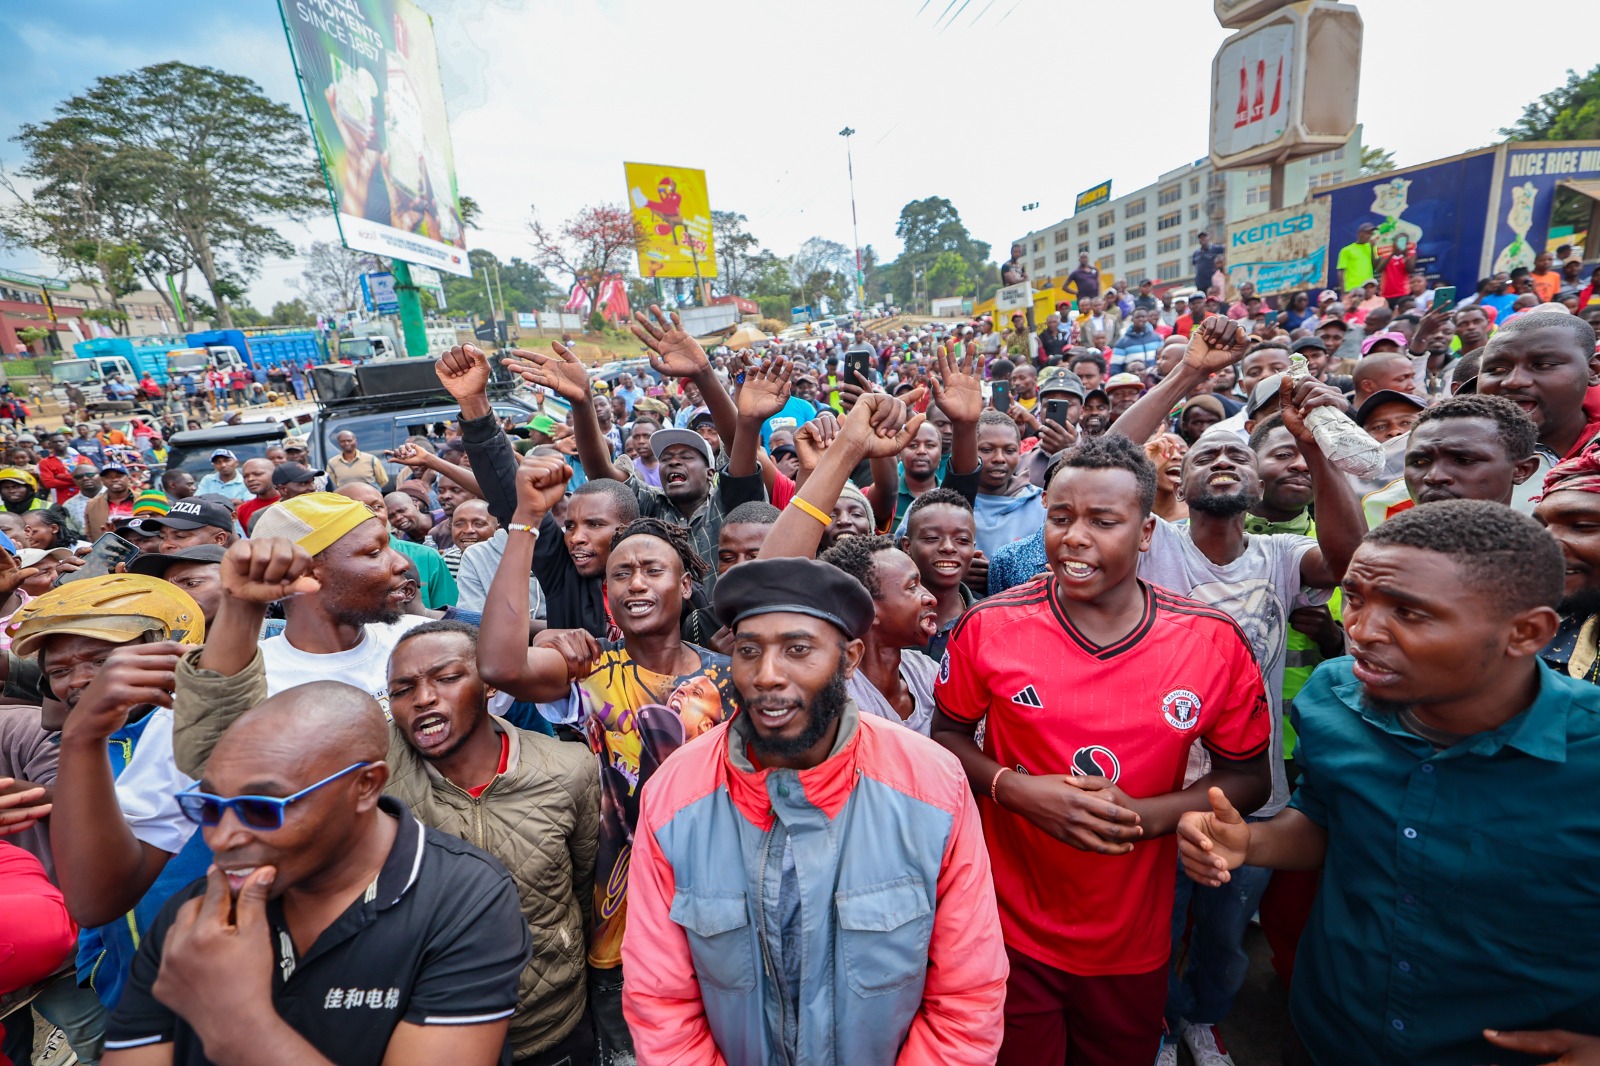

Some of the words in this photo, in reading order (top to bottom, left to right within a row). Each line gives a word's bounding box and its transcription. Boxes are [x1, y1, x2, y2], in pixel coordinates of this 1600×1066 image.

[296, 1, 348, 44] SINCE
[348, 32, 379, 62] 1857
[1509, 152, 1546, 177] NICE
[1544, 150, 1580, 174] RICE
[1578, 150, 1600, 173] MIL
[168, 501, 202, 515] ZIZIA
[1170, 718, 1194, 729] UNITED
[323, 987, 401, 1010] 佳和电梯
